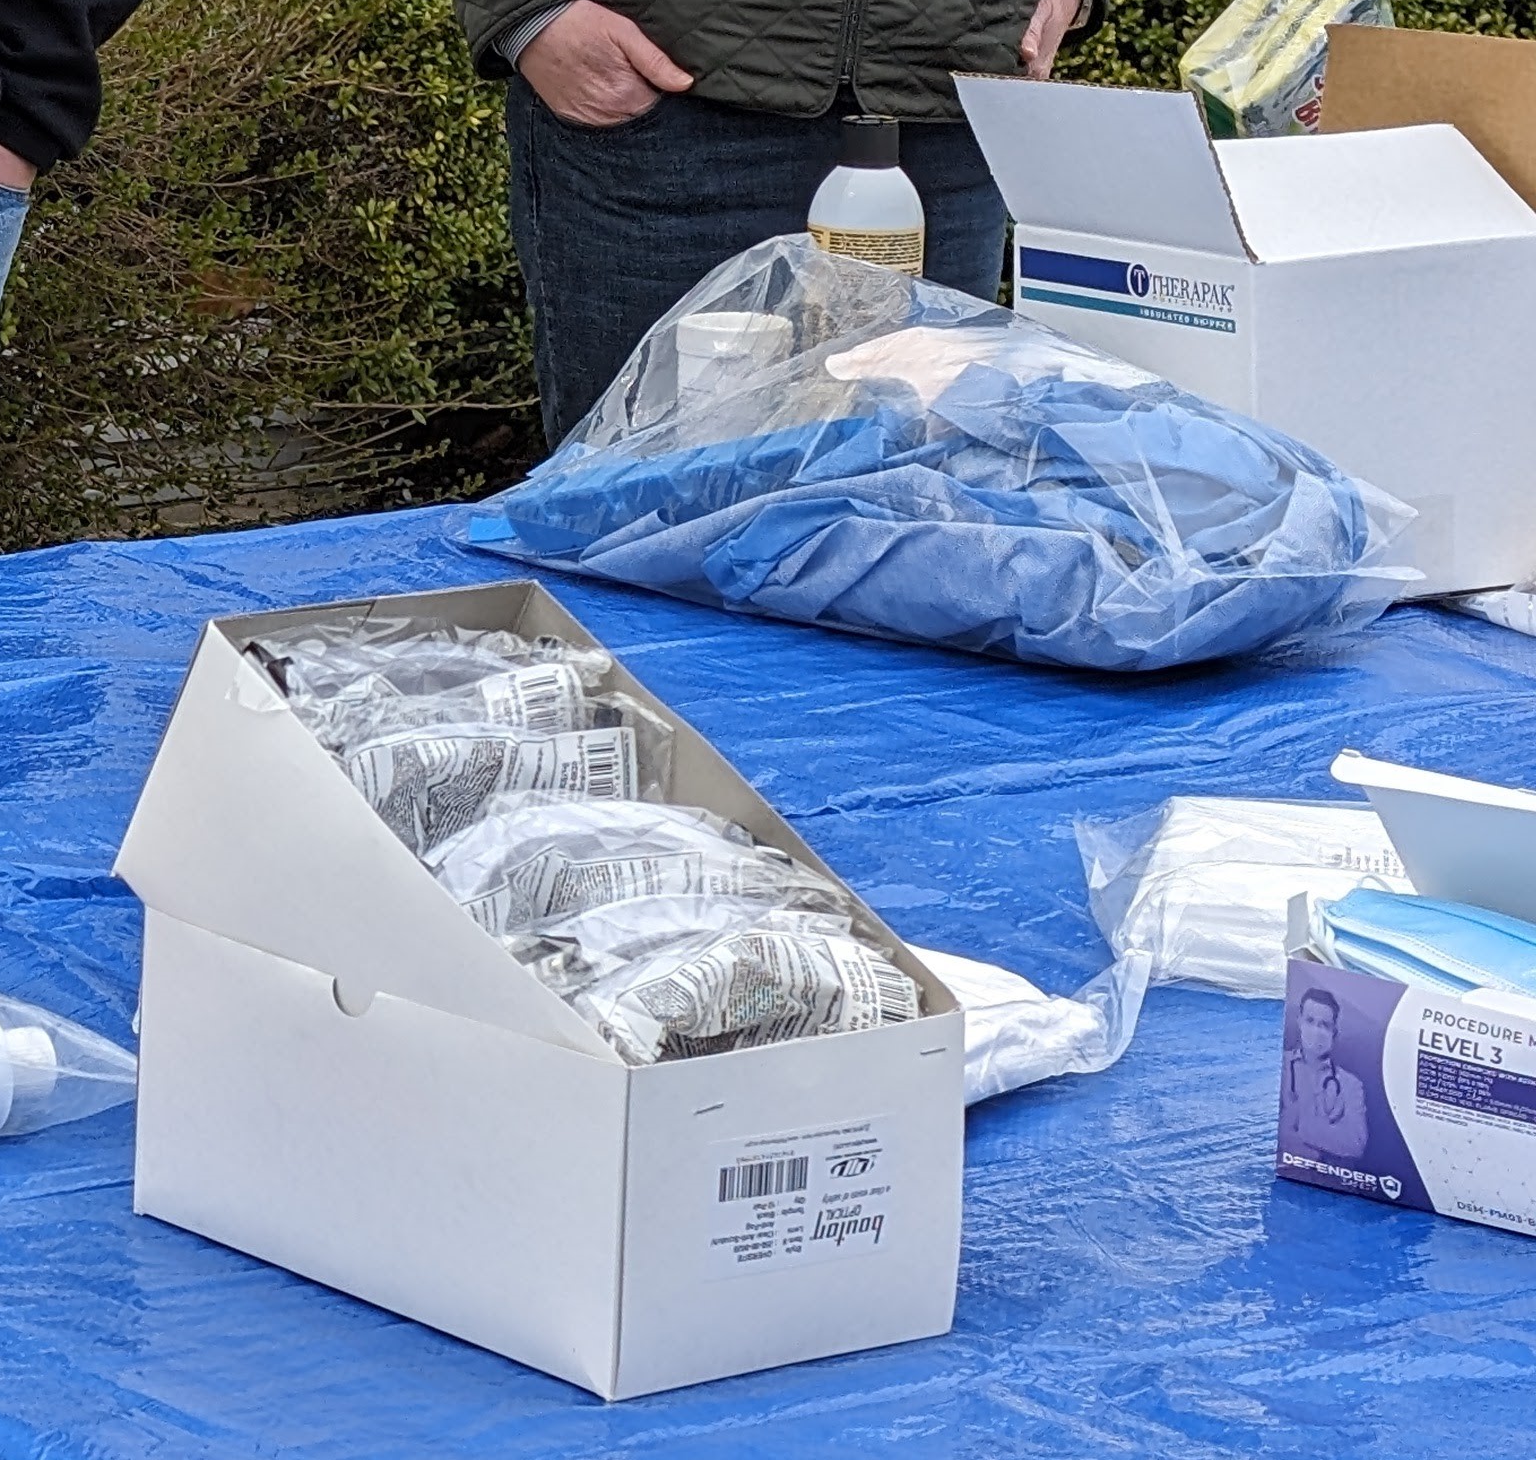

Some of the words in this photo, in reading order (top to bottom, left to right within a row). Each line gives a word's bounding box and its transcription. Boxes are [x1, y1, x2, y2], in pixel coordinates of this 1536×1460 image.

[1151, 273, 1232, 306] THERAPAK
[1139, 307, 1189, 325] INSULATED
[1422, 1008, 1522, 1044] PROCEDURE
[1419, 1029, 1485, 1061] LEVEL
[1490, 1046, 1503, 1065] 3
[1282, 1151, 1378, 1186] DEFENDER
[809, 1211, 885, 1246] bouton
[826, 1204, 862, 1221] OPTICAL
